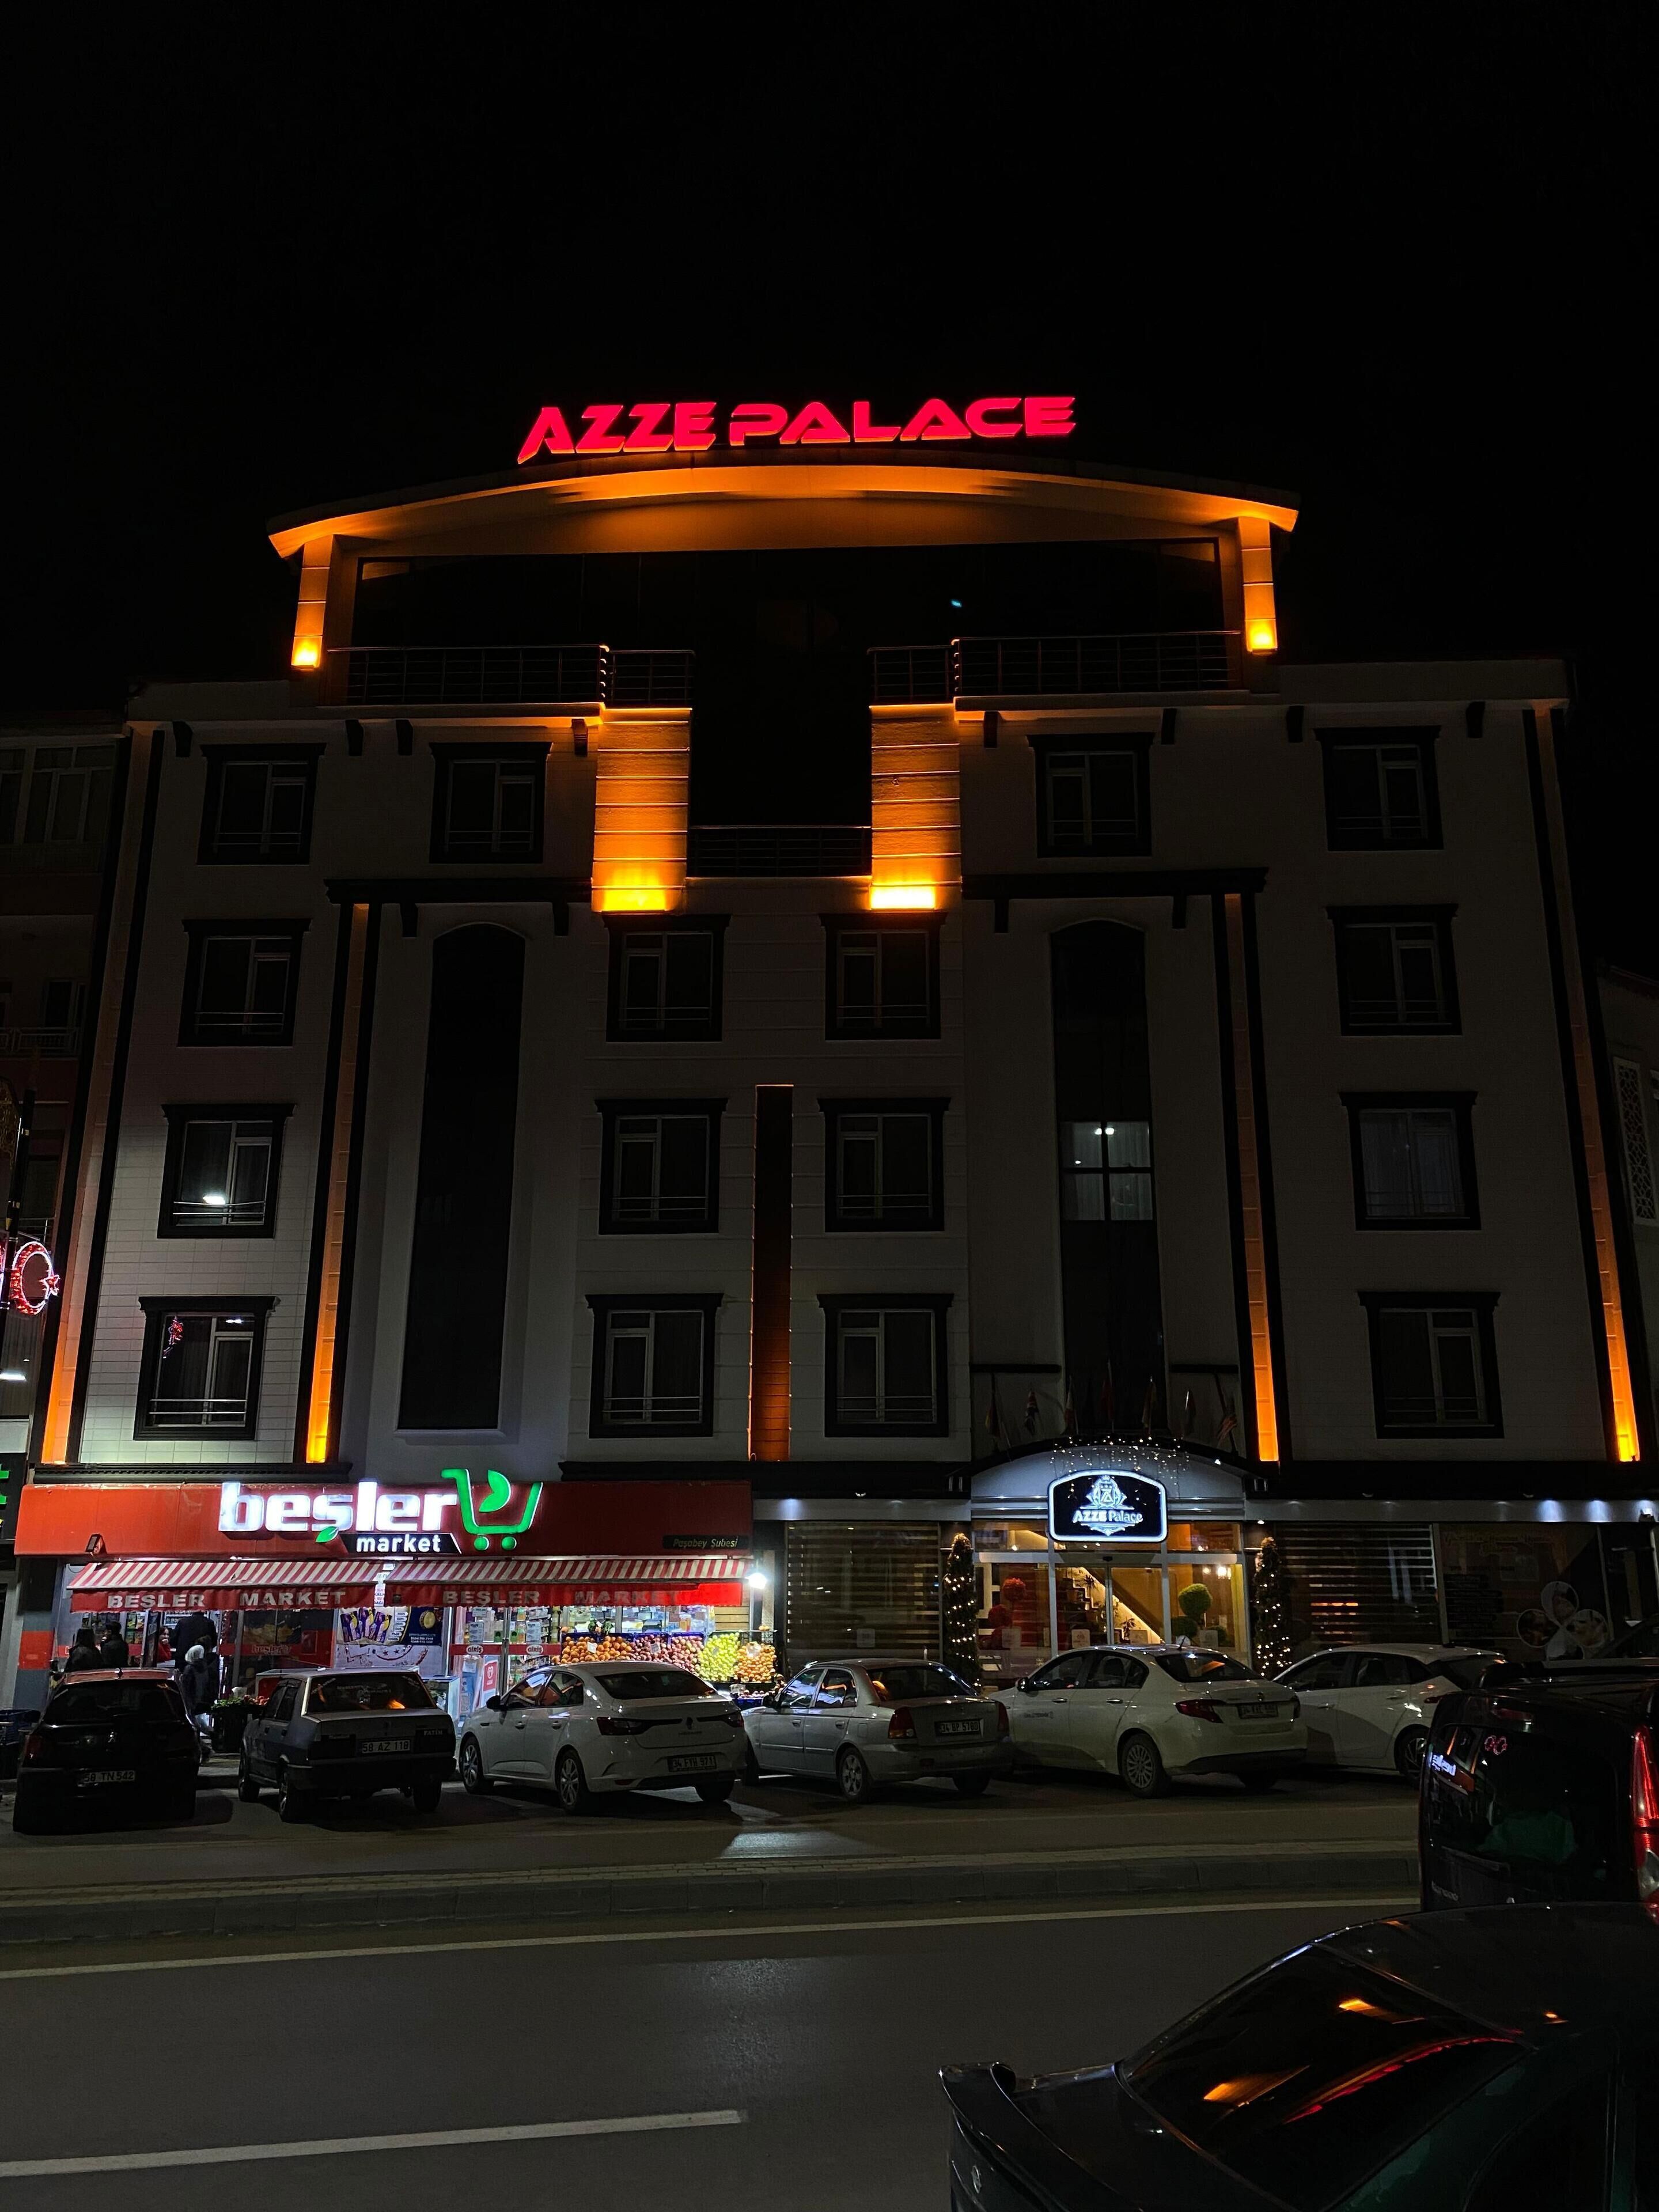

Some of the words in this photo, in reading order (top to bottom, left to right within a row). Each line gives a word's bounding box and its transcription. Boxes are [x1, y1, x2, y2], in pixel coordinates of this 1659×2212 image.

[517, 402, 716, 464] AZZE
[729, 397, 1076, 446] PALACE
[1072, 1510, 1107, 1523] AZZE
[1108, 1510, 1143, 1523] Palace
[356, 1535, 441, 1553] market
[240, 1591, 346, 1607] MARKET
[363, 1744, 373, 1752] 58
[378, 1743, 390, 1751] AZ
[84, 1772, 96, 1782] 58
[101, 1771, 114, 1781] TN
[116, 1771, 134, 1780] 542
